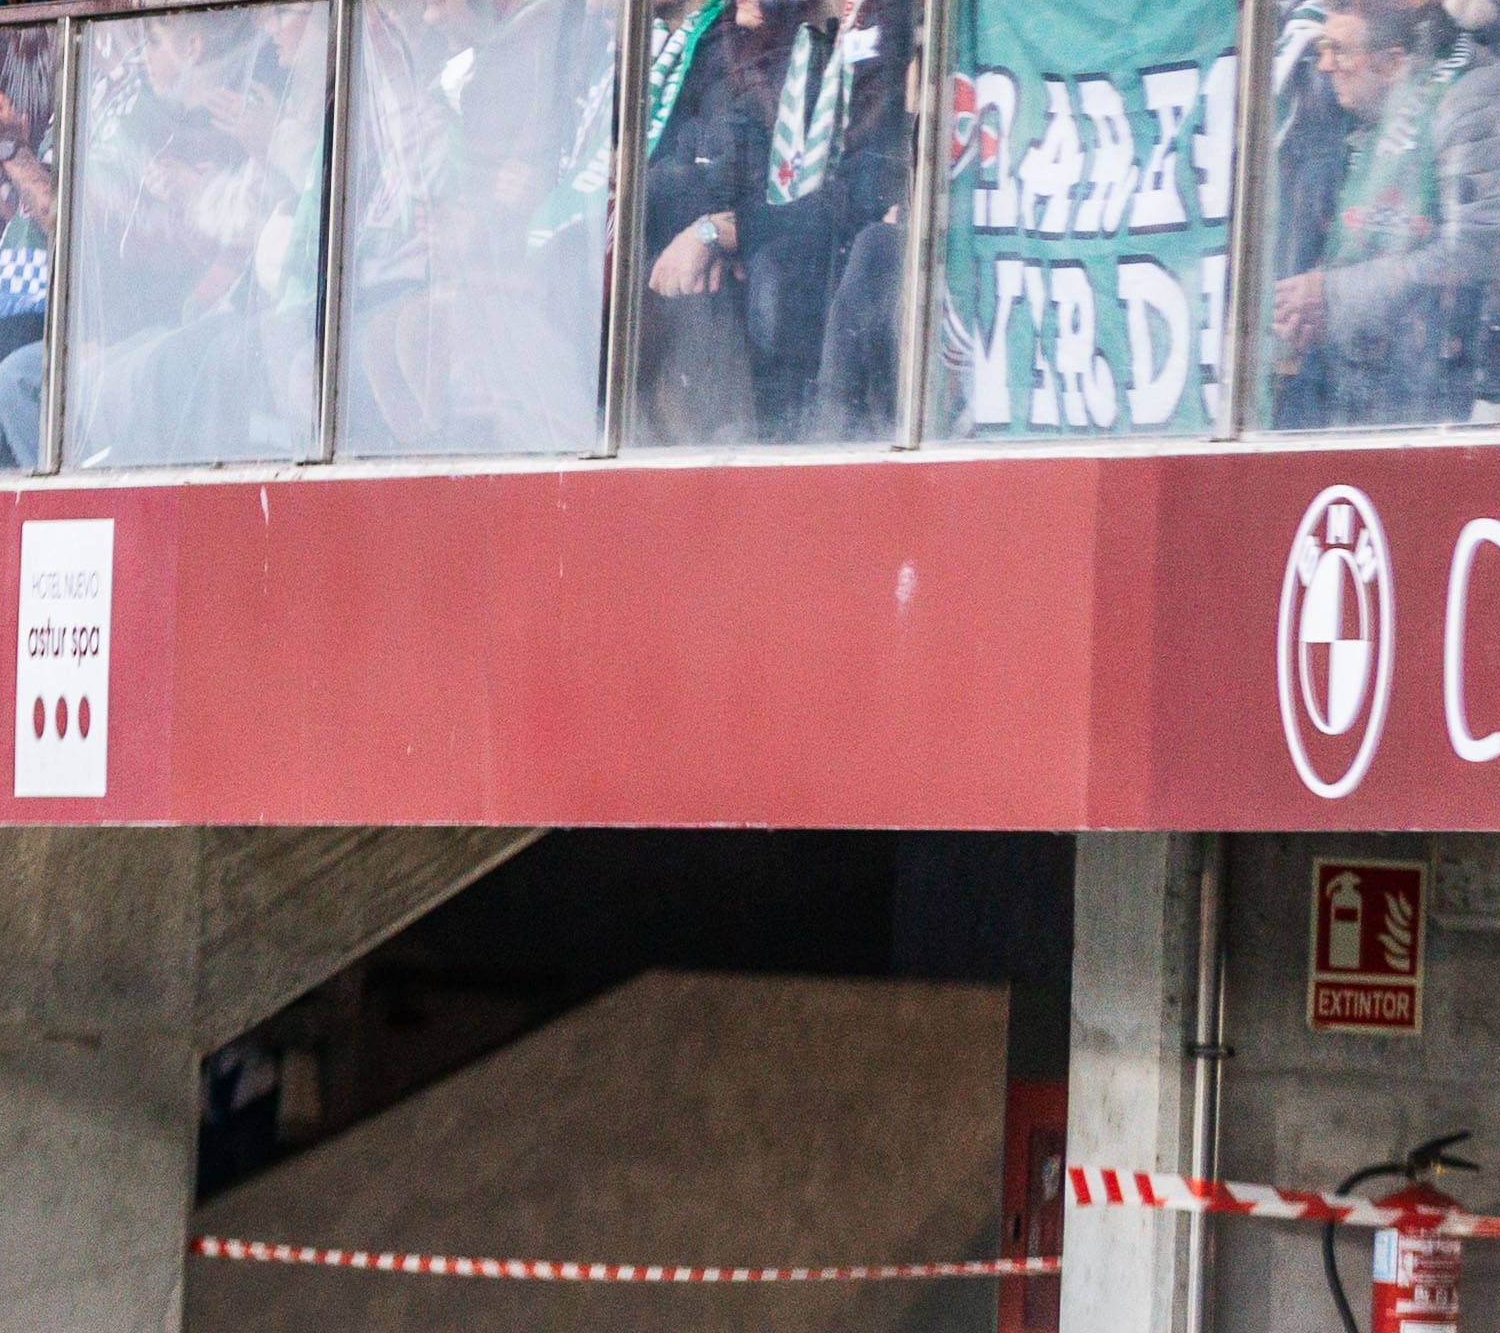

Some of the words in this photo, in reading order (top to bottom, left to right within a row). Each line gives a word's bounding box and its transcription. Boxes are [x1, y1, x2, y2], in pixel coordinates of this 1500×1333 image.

[27, 616, 68, 659] astur
[70, 623, 101, 667] spa
[1319, 988, 1410, 1020] EXTINTOR
